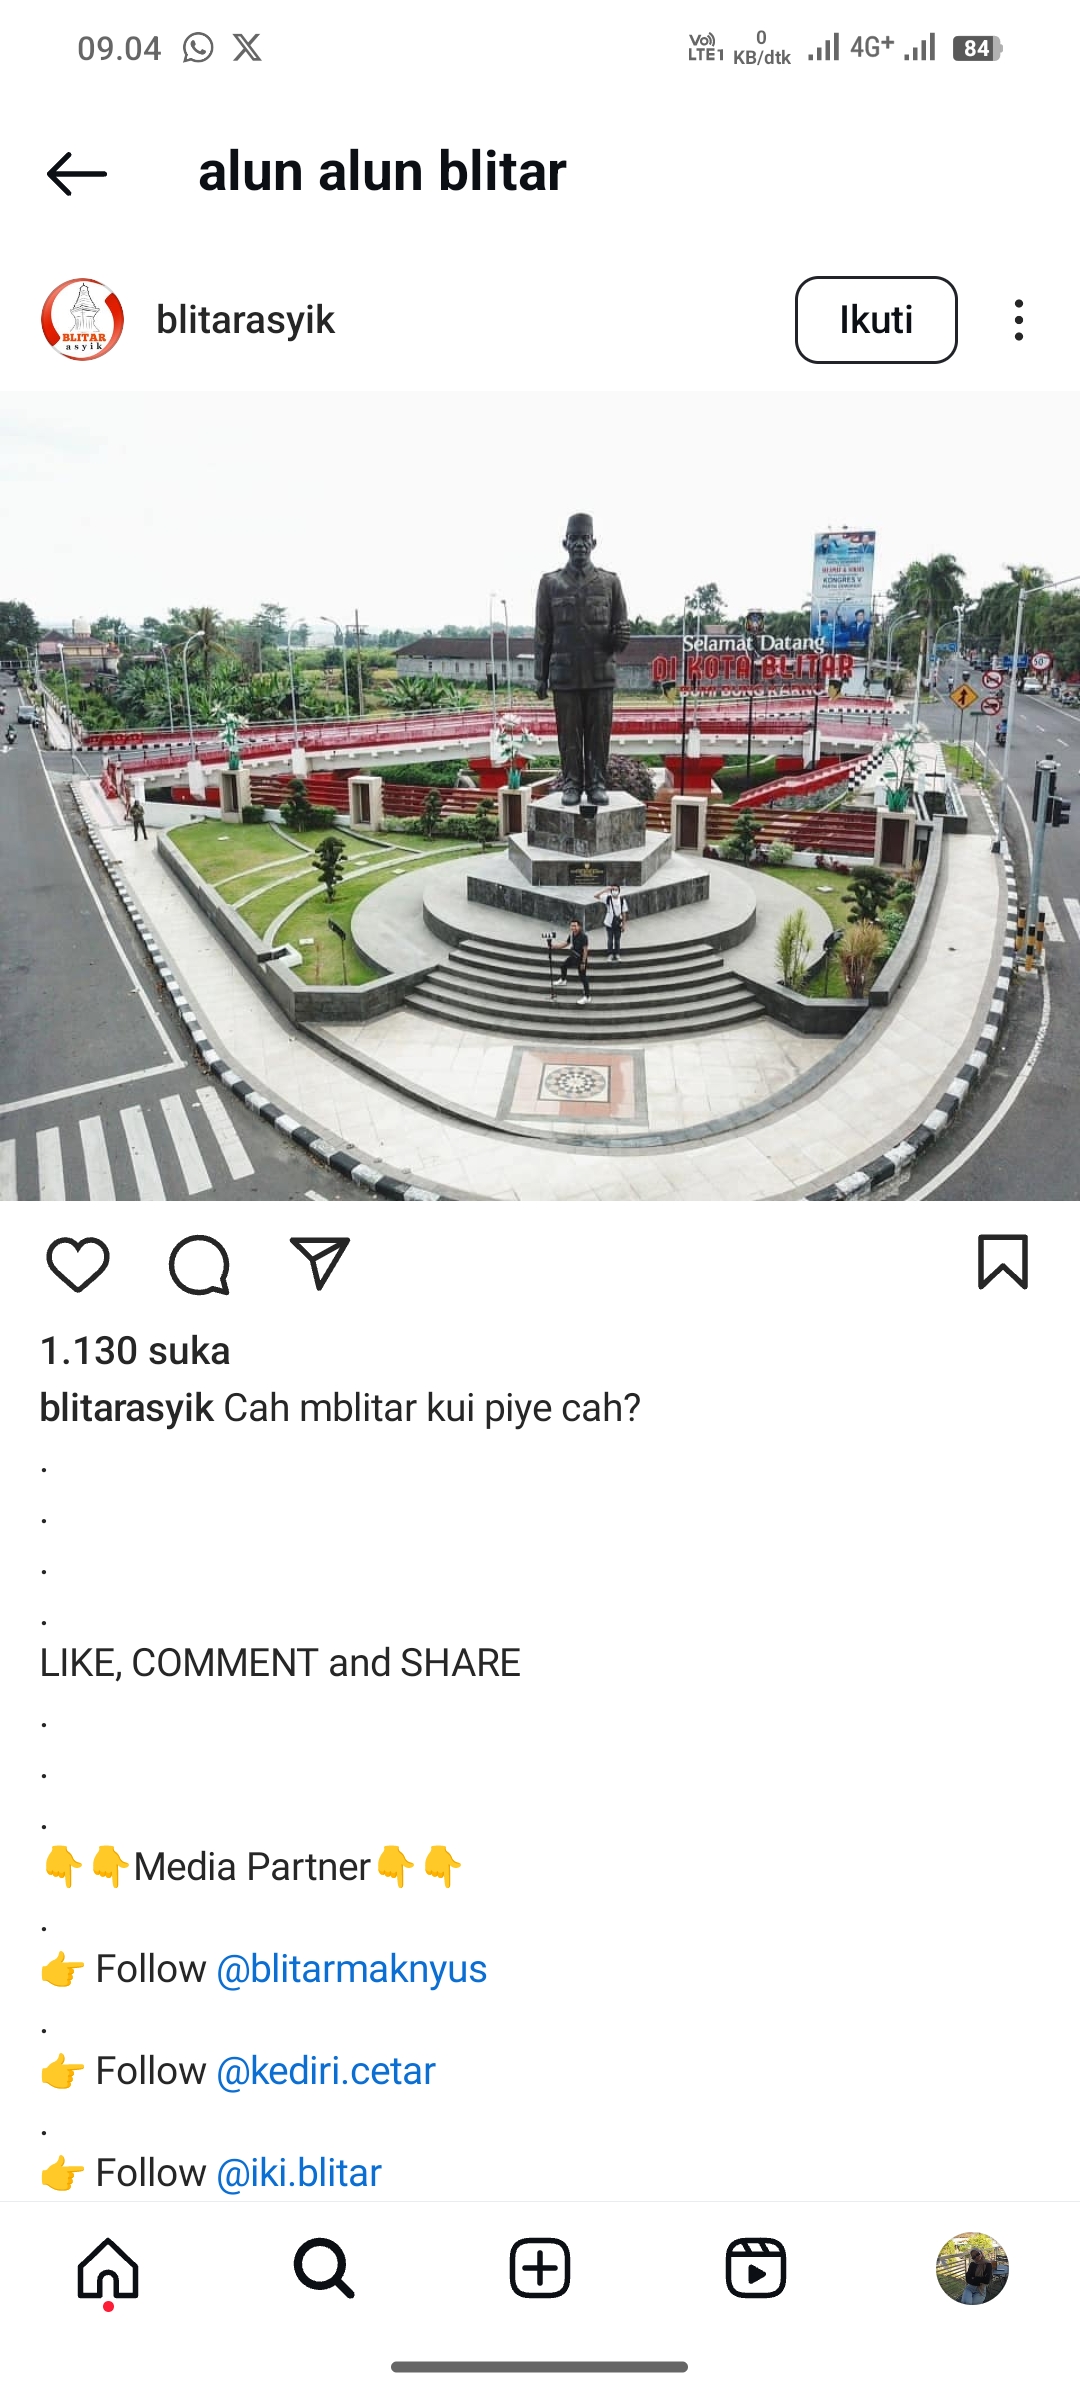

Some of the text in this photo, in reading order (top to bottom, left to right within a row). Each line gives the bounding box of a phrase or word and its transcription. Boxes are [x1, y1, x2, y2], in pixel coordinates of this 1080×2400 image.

[78, 35, 162, 62] 09.04
[756, 29, 767, 46] 0
[963, 40, 990, 57] 84
[733, 49, 792, 66] KB/dtk
[199, 148, 568, 193] alun alun blitar
[157, 303, 336, 342] blitarasyik
[841, 303, 913, 335] Ikuti
[62, 333, 107, 342] BLITAR
[65, 342, 103, 352] asyik
[683, 634, 826, 654] Selamat Datang
[652, 653, 855, 681] DI KOTA BLITAR
[679, 685, 717, 698] BUMI
[720, 684, 765, 698] BUNG
[41, 1334, 230, 1366] 1.130 suka
[40, 1391, 641, 1430] blitarasyik Cah mblitar kui piye cah?
[41, 1646, 521, 1682] LIKE, COMMENT and SHARE
[135, 1851, 372, 1882] Media Partner
[97, 1951, 487, 1992] Follow @blitarmaknyus
[97, 2053, 437, 2094] Follow @kediri.cetar
[97, 2155, 383, 2196] Follow @iki.blitar
